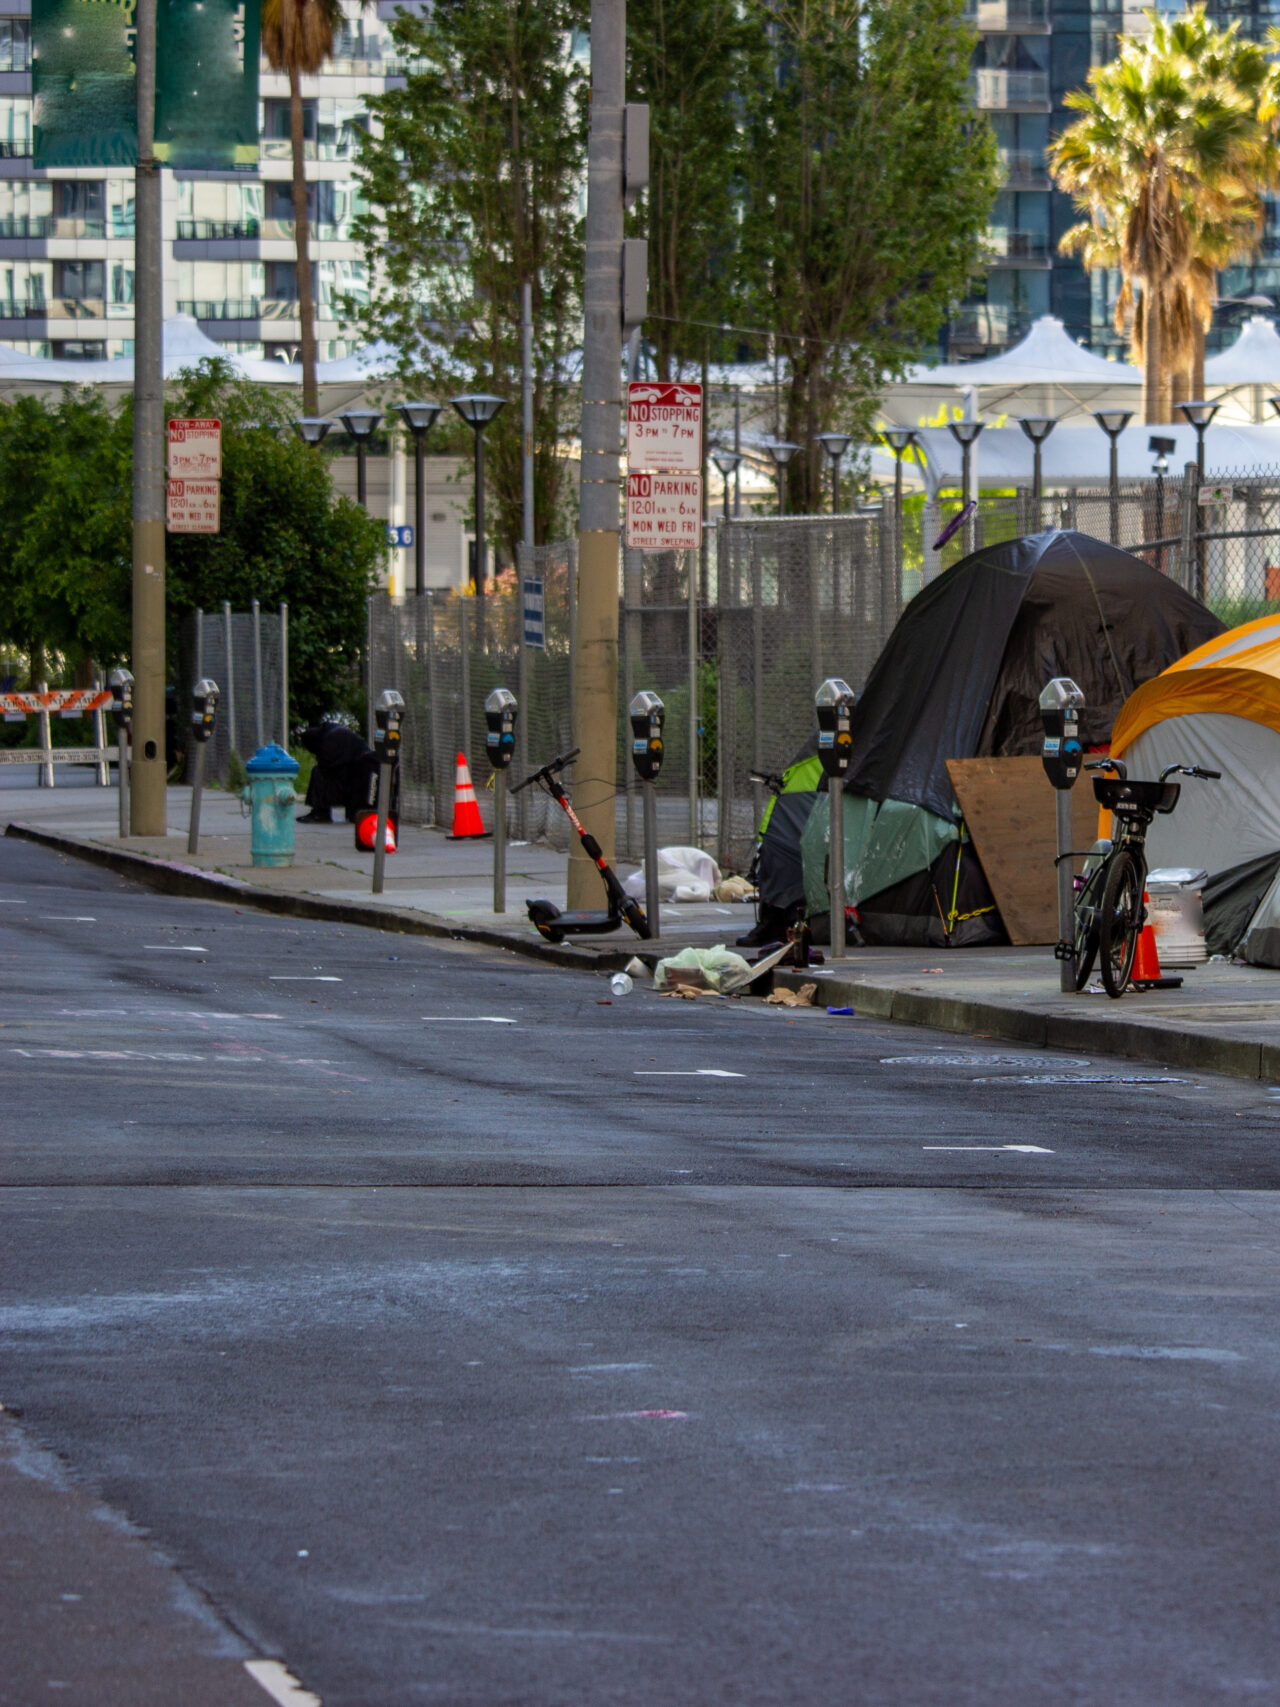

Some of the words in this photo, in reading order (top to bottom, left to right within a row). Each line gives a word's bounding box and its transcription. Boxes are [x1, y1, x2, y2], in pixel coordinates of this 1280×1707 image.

[631, 405, 648, 421] NO
[651, 407, 699, 421] STOPPING
[175, 421, 215, 429] TOW-AWAY
[635, 425, 643, 438] 3
[672, 425, 680, 438] 7
[171, 429, 185, 442] NO
[187, 430, 219, 439] STOPPING
[170, 481, 183, 495] NO
[186, 485, 217, 496] PARKING
[630, 477, 649, 496] NO
[654, 481, 698, 496] PARKING
[172, 512, 185, 520] MON
[189, 512, 201, 520] WED
[206, 512, 215, 520] FRI
[633, 521, 653, 533] MON
[658, 521, 677, 533] WED
[682, 521, 696, 533] FRI
[633, 538, 657, 546] STREET
[661, 538, 695, 546] SWEEPING
